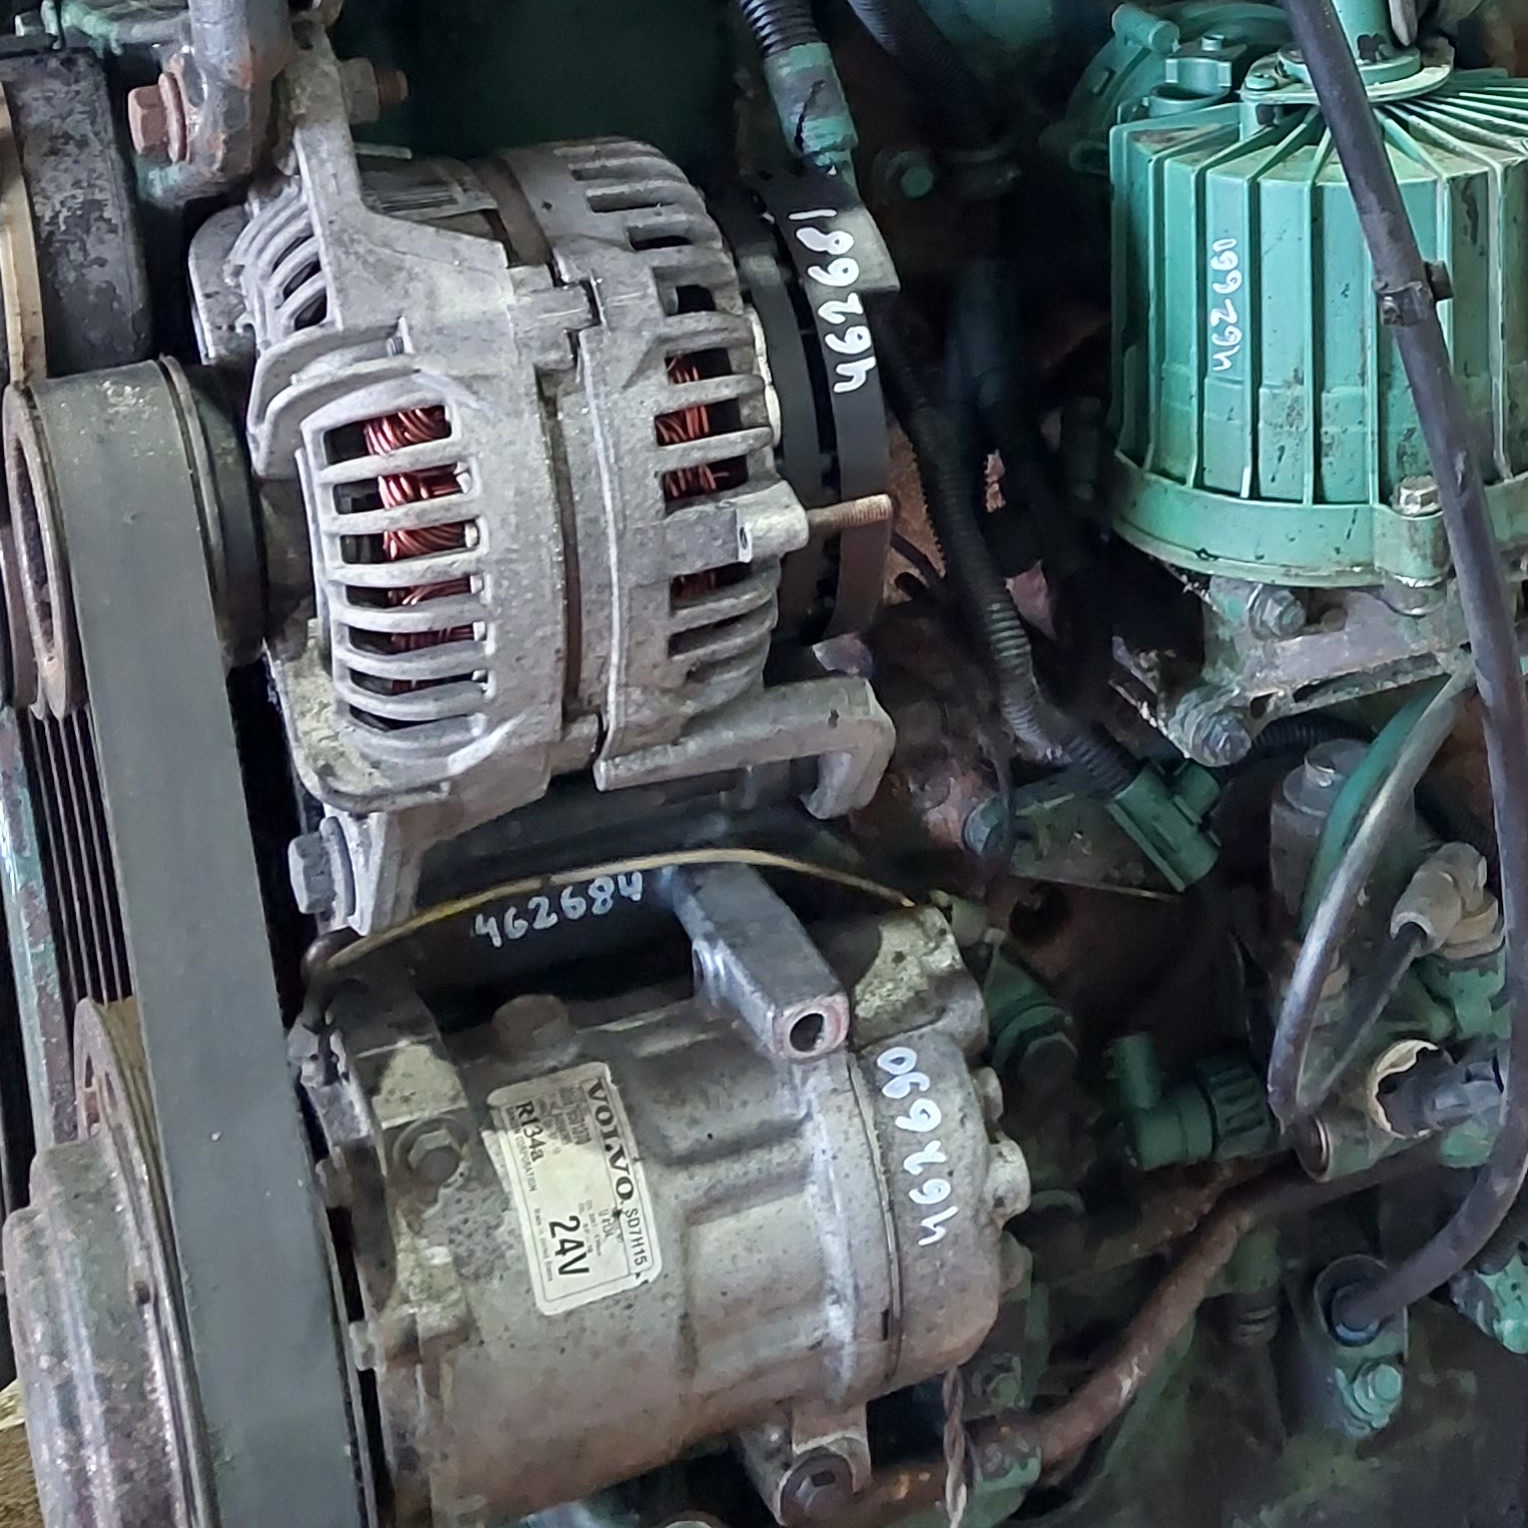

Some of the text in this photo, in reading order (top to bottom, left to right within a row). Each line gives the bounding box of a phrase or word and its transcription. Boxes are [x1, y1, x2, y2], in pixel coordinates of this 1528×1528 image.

[788, 209, 876, 393] 462681
[475, 871, 643, 948] 462684
[515, 1100, 545, 1162] R134a
[587, 1081, 634, 1201] VOLVO
[548, 1214, 590, 1276] 24V
[625, 1207, 648, 1267] SD7H15
